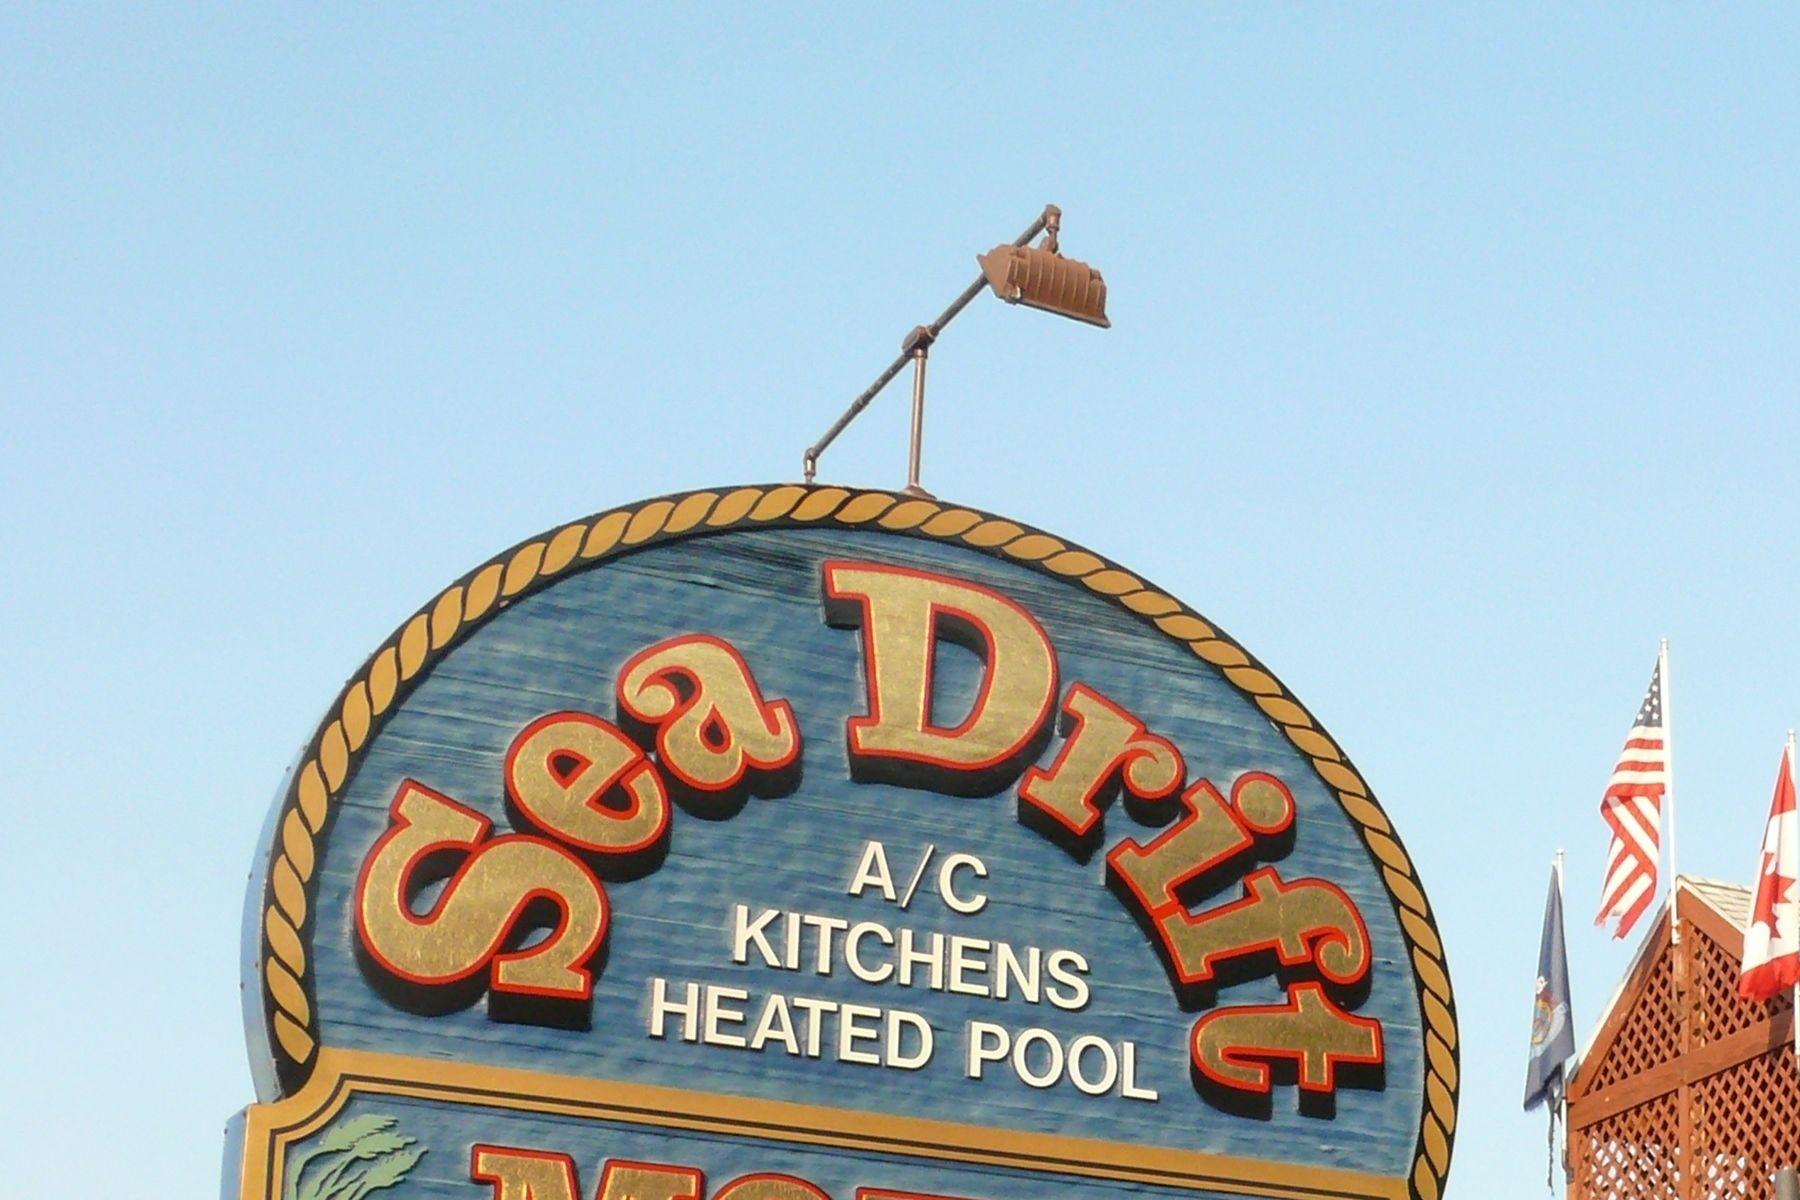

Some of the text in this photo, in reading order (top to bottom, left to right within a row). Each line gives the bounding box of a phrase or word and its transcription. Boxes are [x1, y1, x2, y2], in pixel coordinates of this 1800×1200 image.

[354, 560, 1386, 1094] Sea Drift
[849, 840, 988, 913] A/C
[732, 905, 1090, 1010] KITCHENS
[649, 978, 1159, 1100] HEATED POOL
